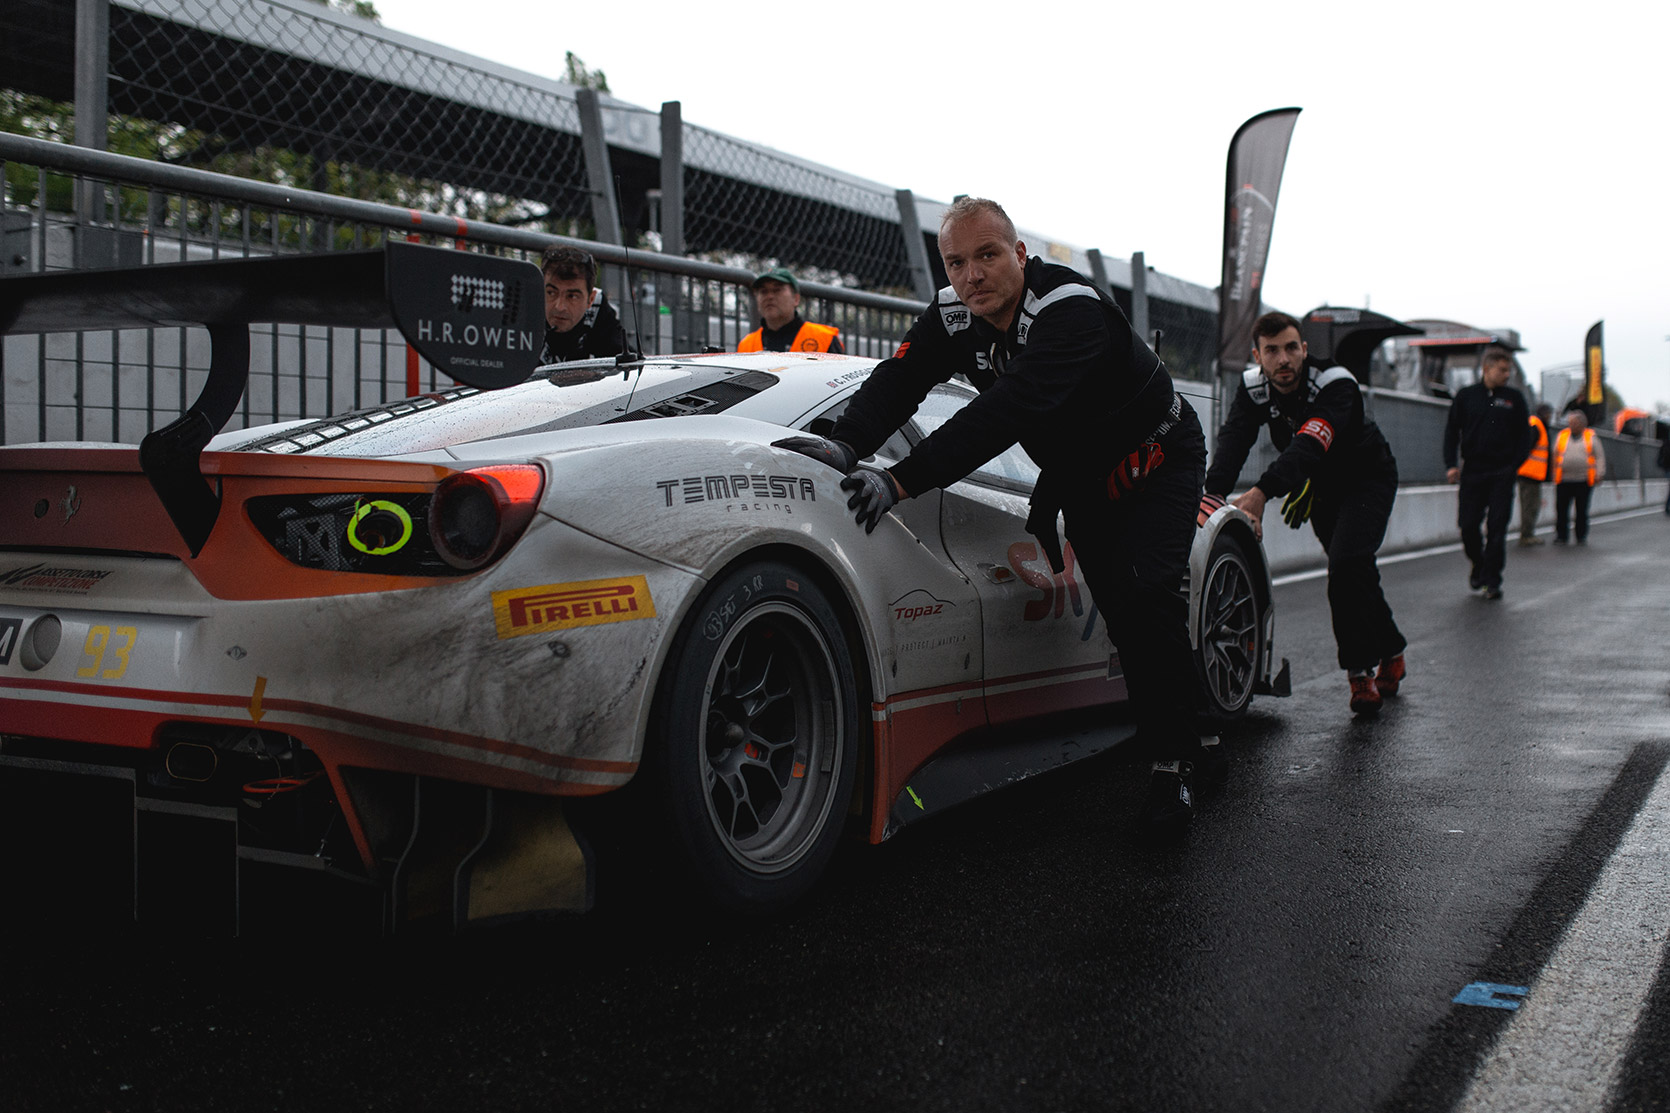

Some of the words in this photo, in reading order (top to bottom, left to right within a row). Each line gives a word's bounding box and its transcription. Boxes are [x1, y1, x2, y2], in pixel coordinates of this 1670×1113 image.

[946, 312, 968, 323] OMP
[417, 318, 534, 352] H.R.OWEN
[449, 356, 479, 367] OFFICIAL
[480, 359, 505, 369] DEALER
[656, 474, 816, 508] TEMPESTA
[726, 502, 793, 514] racing
[508, 584, 639, 628] PIRELLI
[894, 604, 944, 621] Topaz
[76, 624, 138, 680] 93
